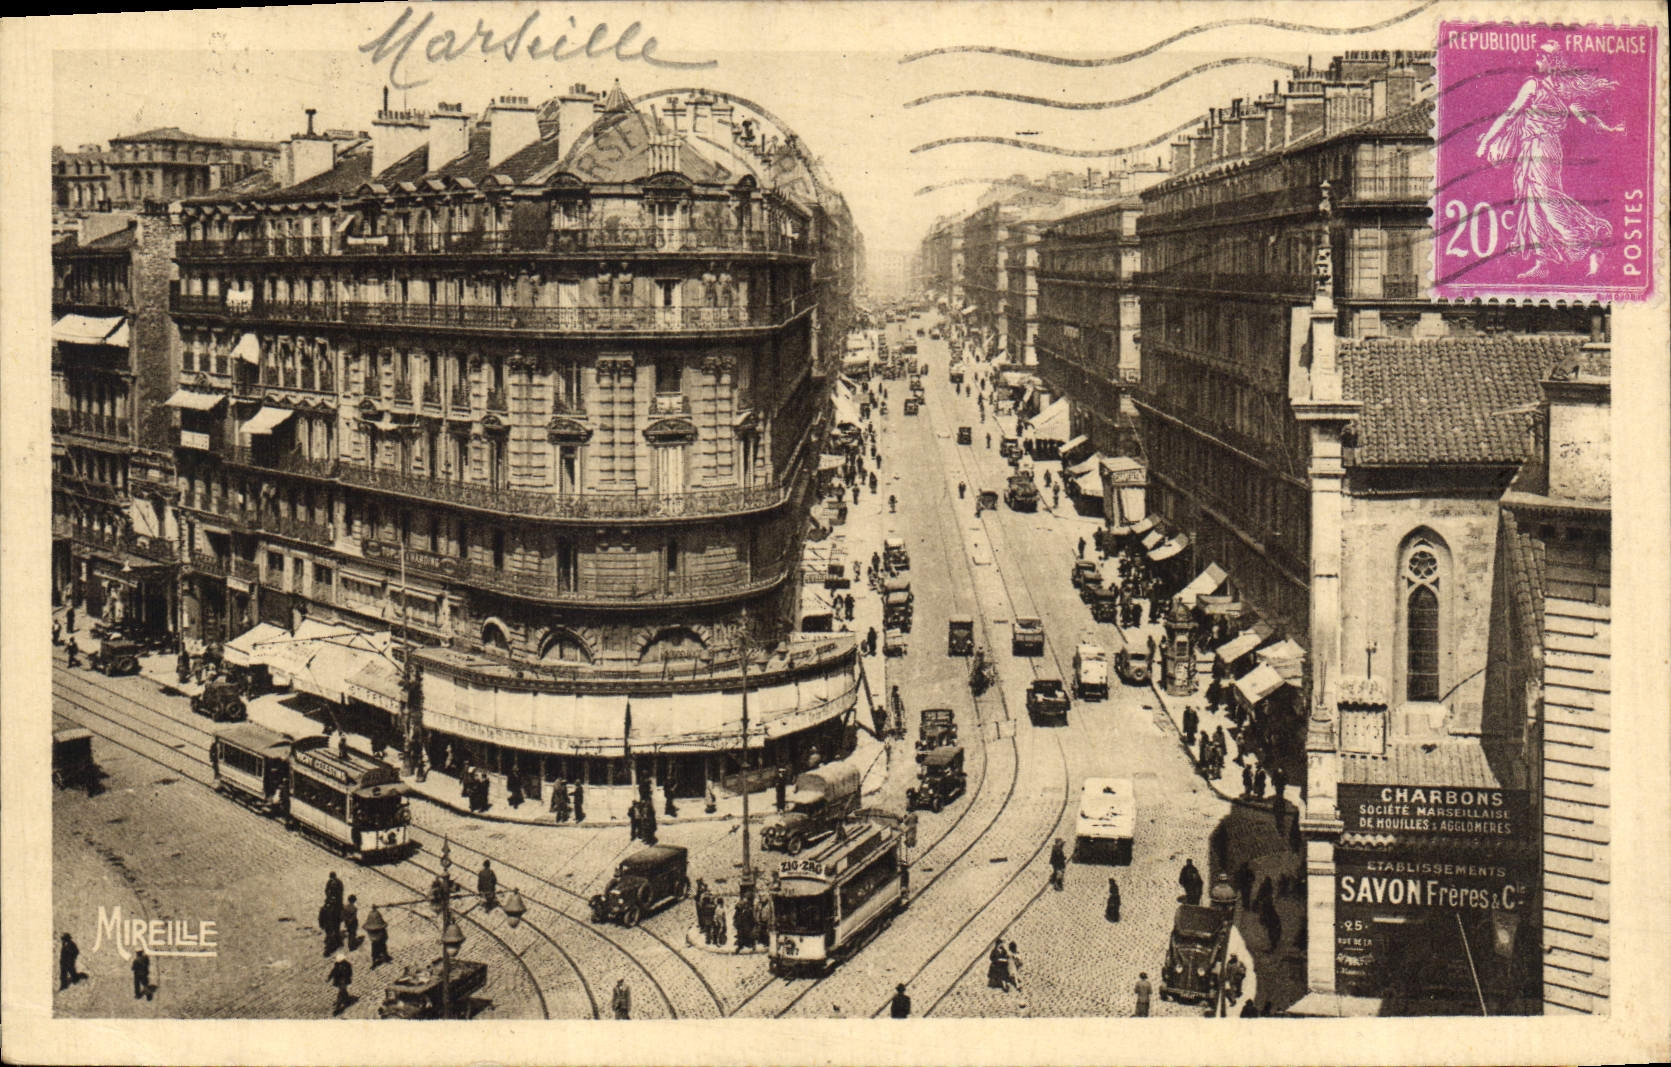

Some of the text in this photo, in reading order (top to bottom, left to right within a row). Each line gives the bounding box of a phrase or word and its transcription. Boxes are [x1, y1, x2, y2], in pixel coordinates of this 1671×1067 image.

[359, 5, 719, 90] Marseille
[1565, 34, 1647, 54] FRANÇAISE
[1623, 189, 1644, 276] POSTES
[1381, 787, 1504, 807] CHARBONS
[1359, 803, 1509, 819] SOCIÉTÉ MARSEILLAISE
[1359, 817, 1374, 829] DE
[1341, 875, 1422, 906] SAVON
[1426, 879, 1489, 909] Frères
[1490, 893, 1500, 910] &
